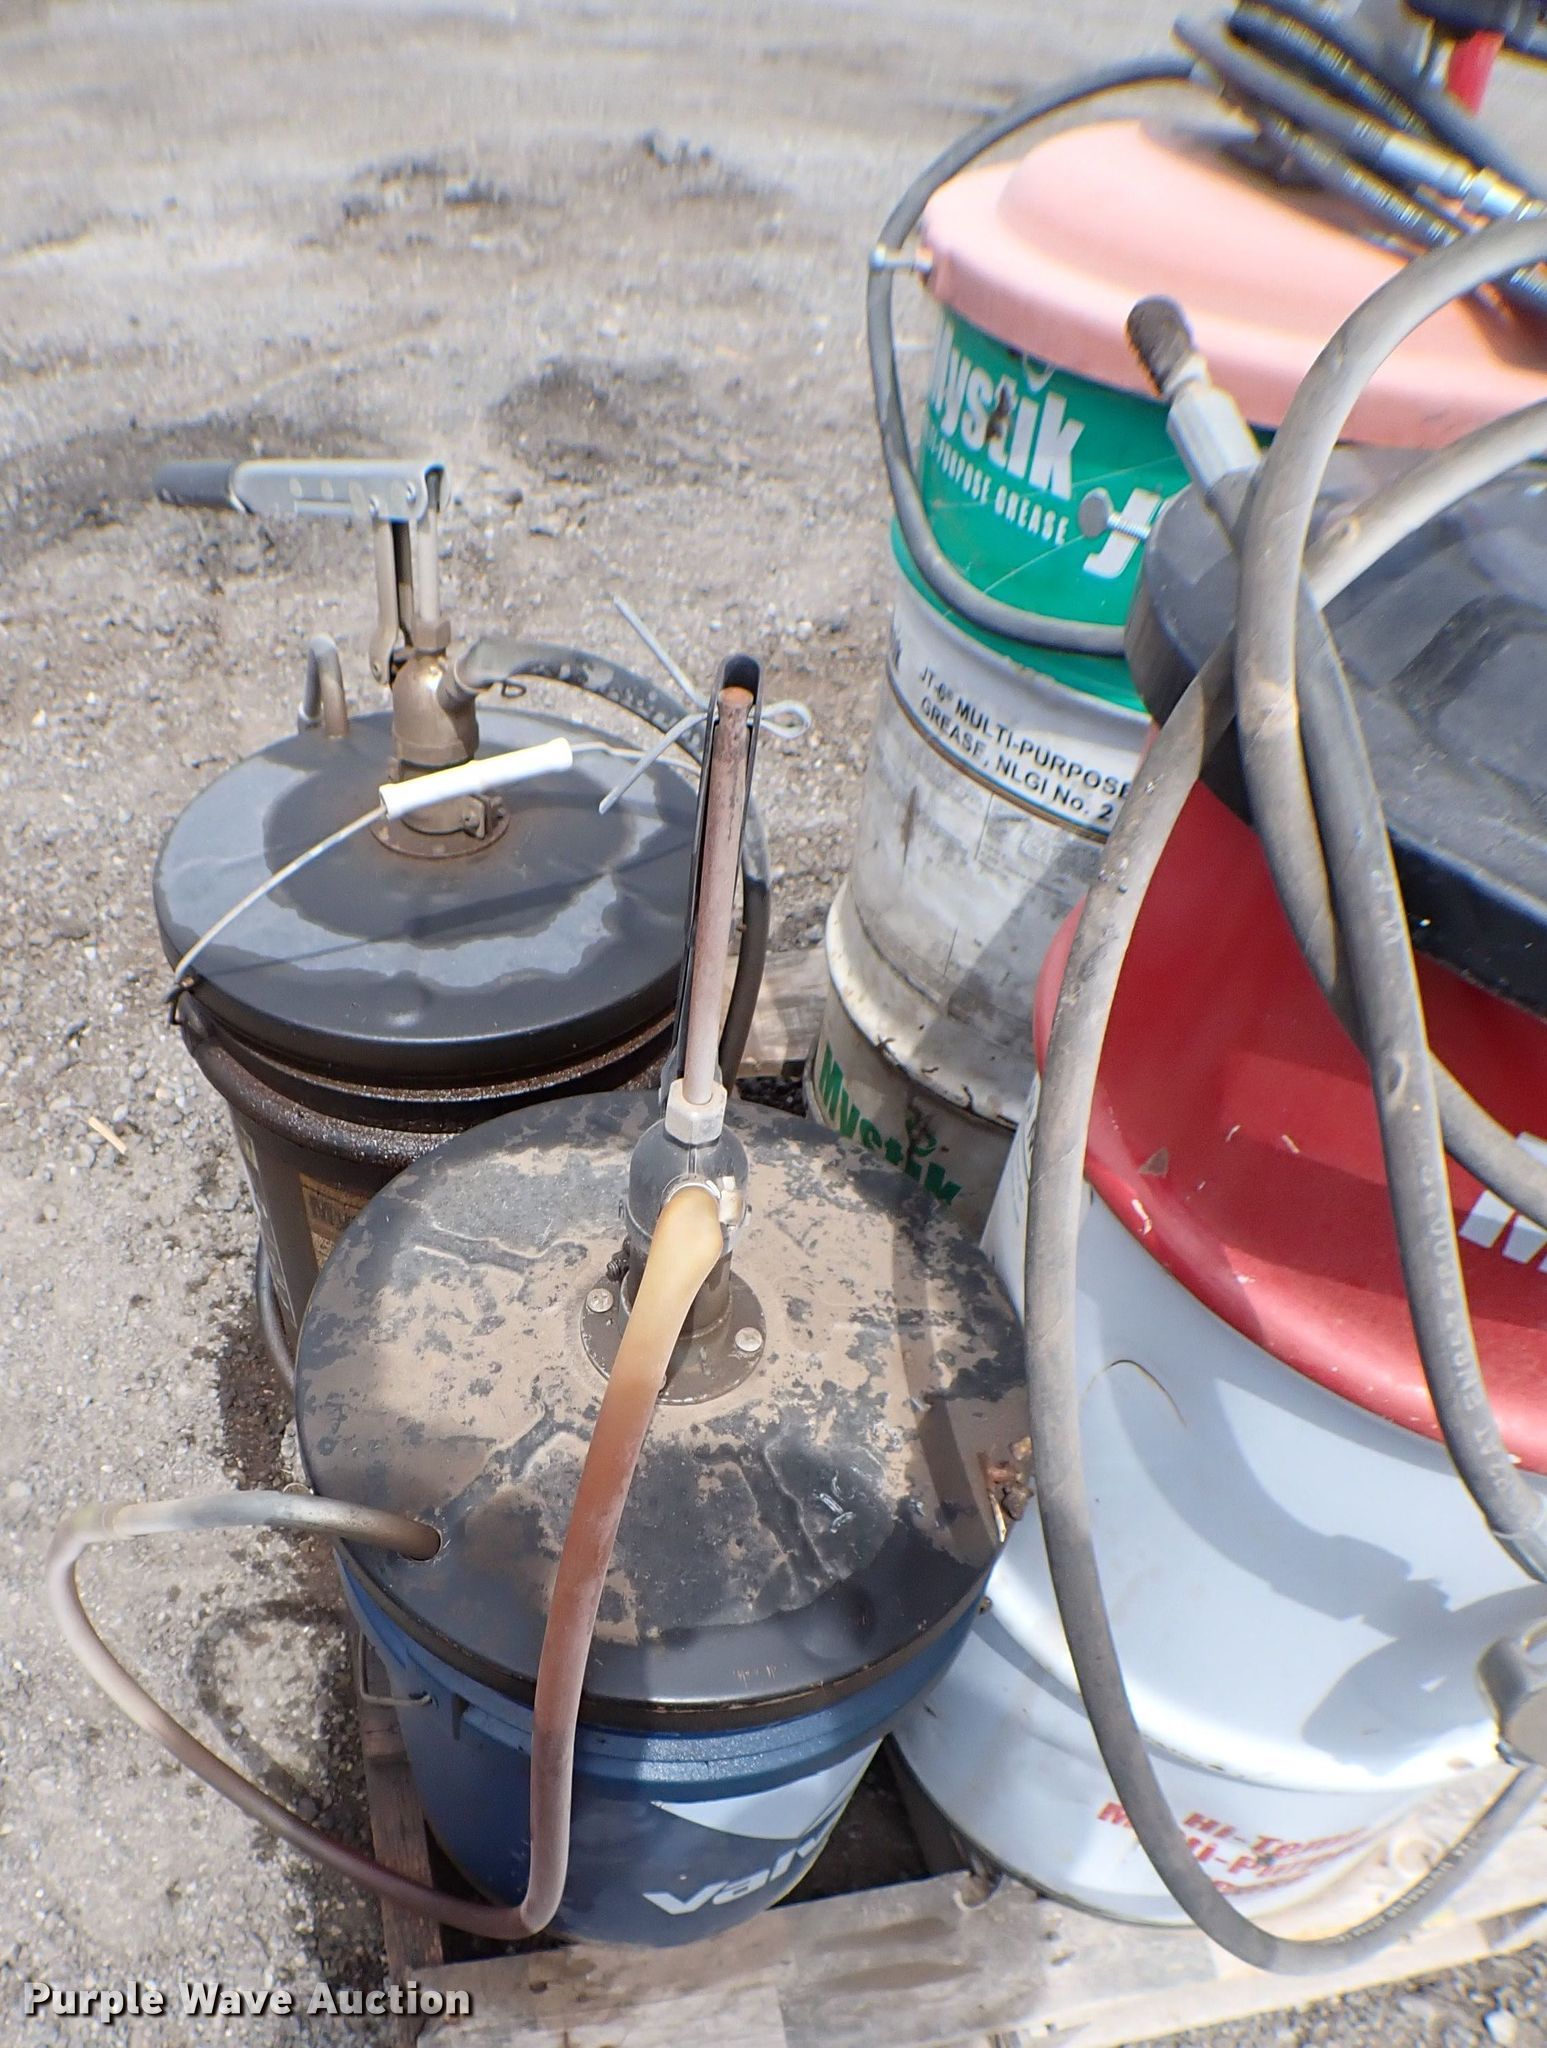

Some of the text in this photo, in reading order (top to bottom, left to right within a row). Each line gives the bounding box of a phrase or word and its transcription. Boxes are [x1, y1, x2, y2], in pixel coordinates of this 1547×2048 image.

[994, 486, 1070, 546] GREASE
[996, 755, 1048, 796] NLGI
[1053, 784, 1090, 816] No.
[1098, 802, 1115, 822] 2
